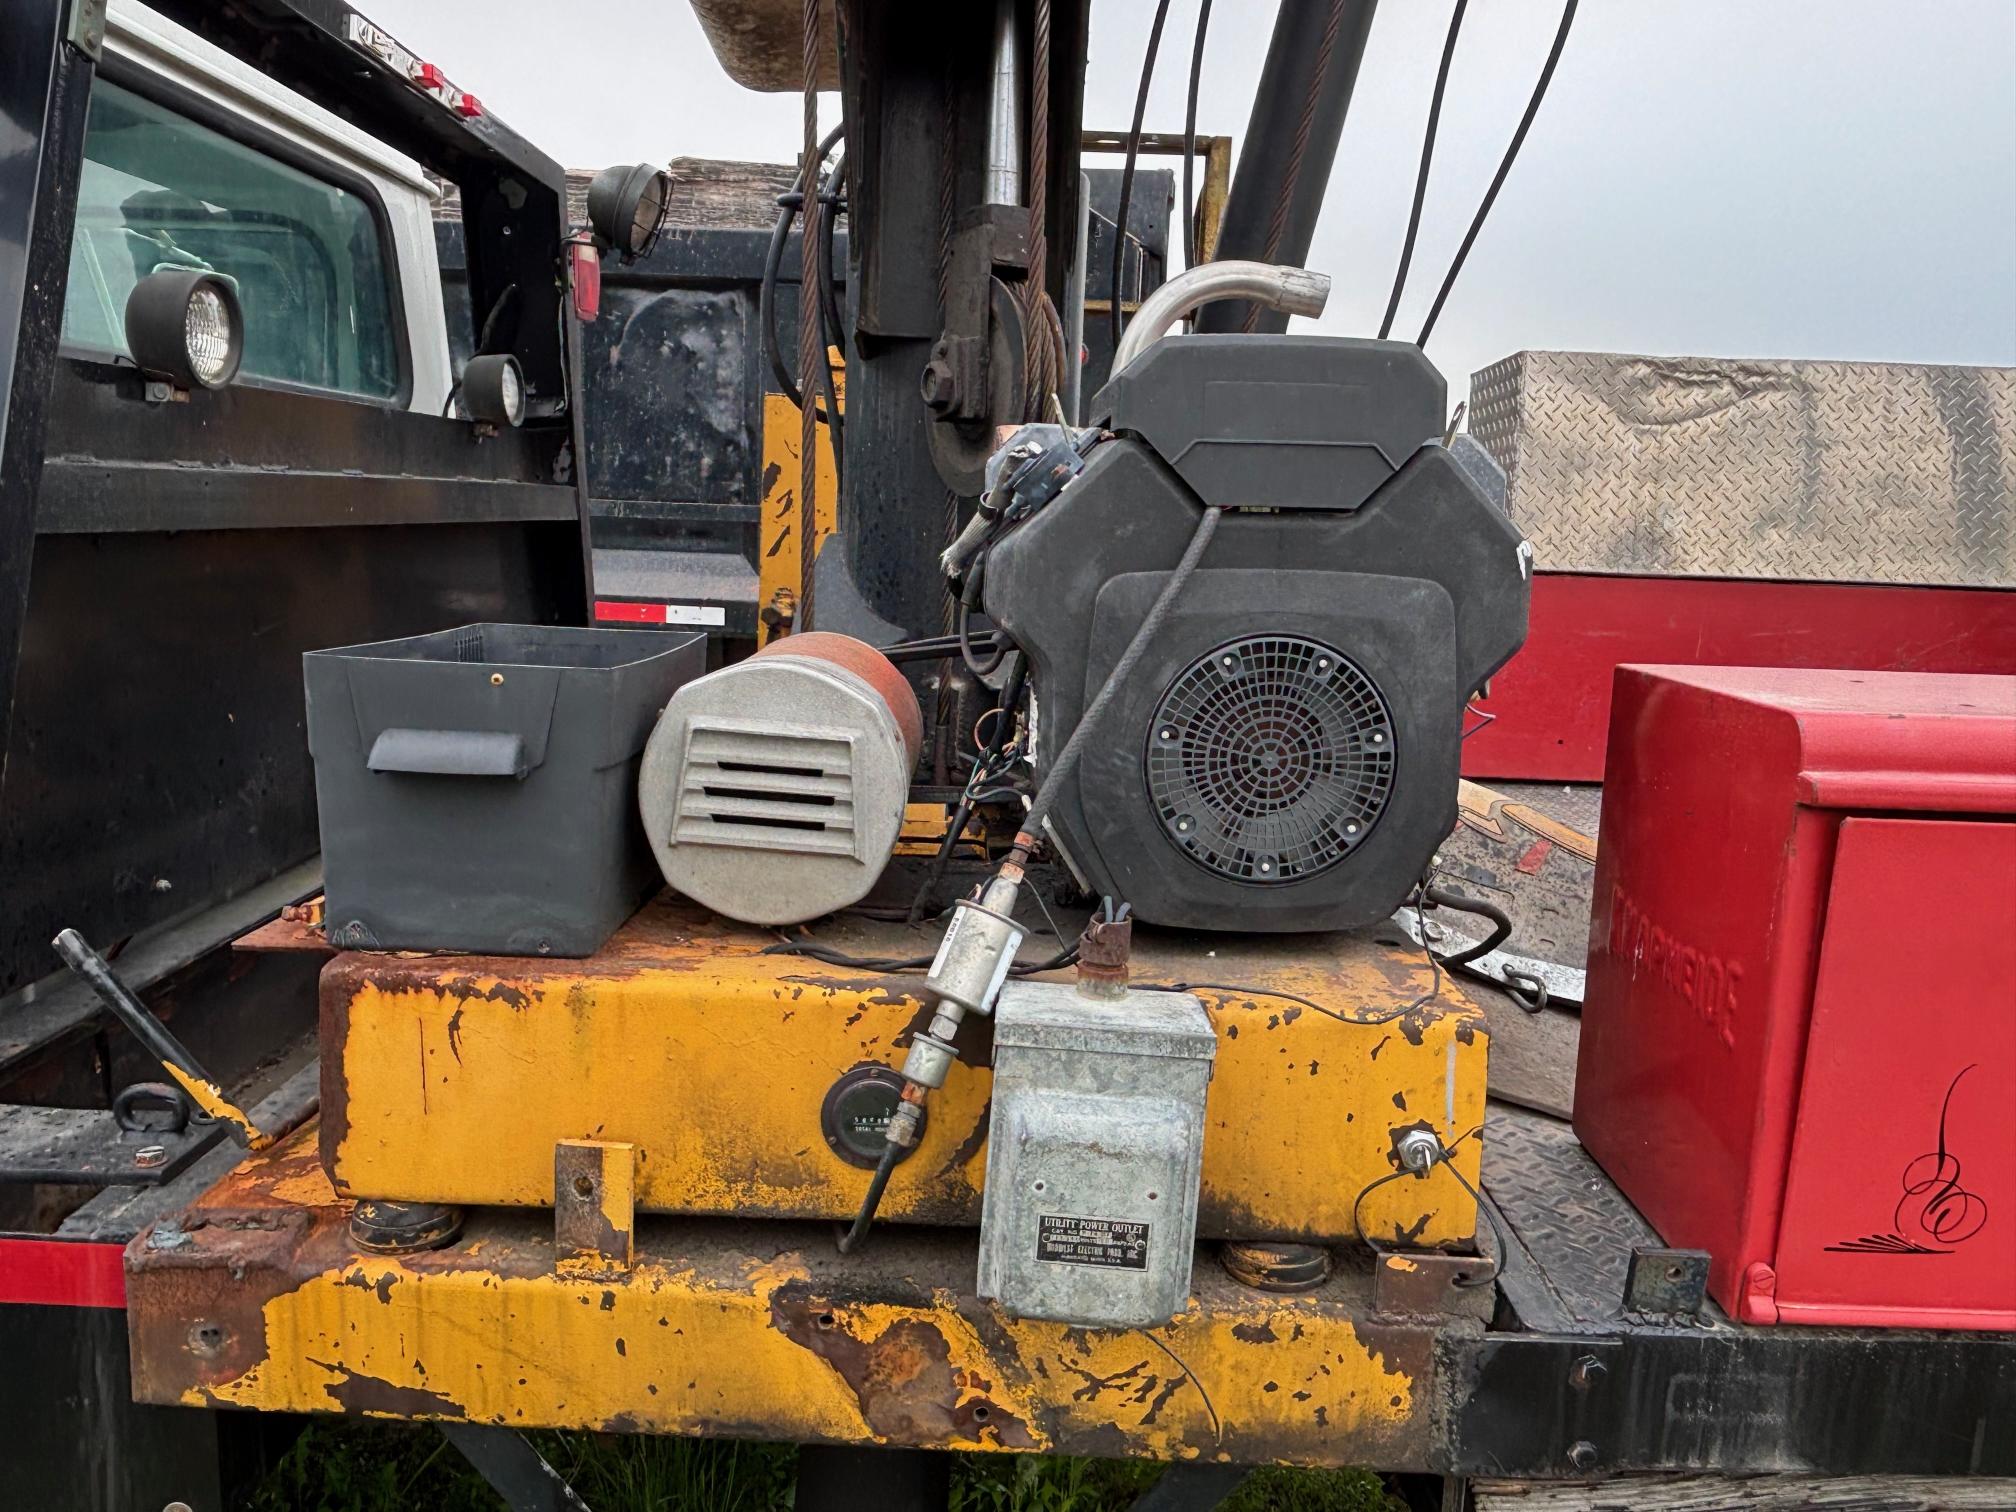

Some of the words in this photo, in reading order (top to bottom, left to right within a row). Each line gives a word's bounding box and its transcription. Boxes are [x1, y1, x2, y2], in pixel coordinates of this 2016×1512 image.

[1045, 1217, 1078, 1228] UTILITY
[1080, 1220, 1109, 1231] POWER
[1111, 1223, 1144, 1234] OUTLET
